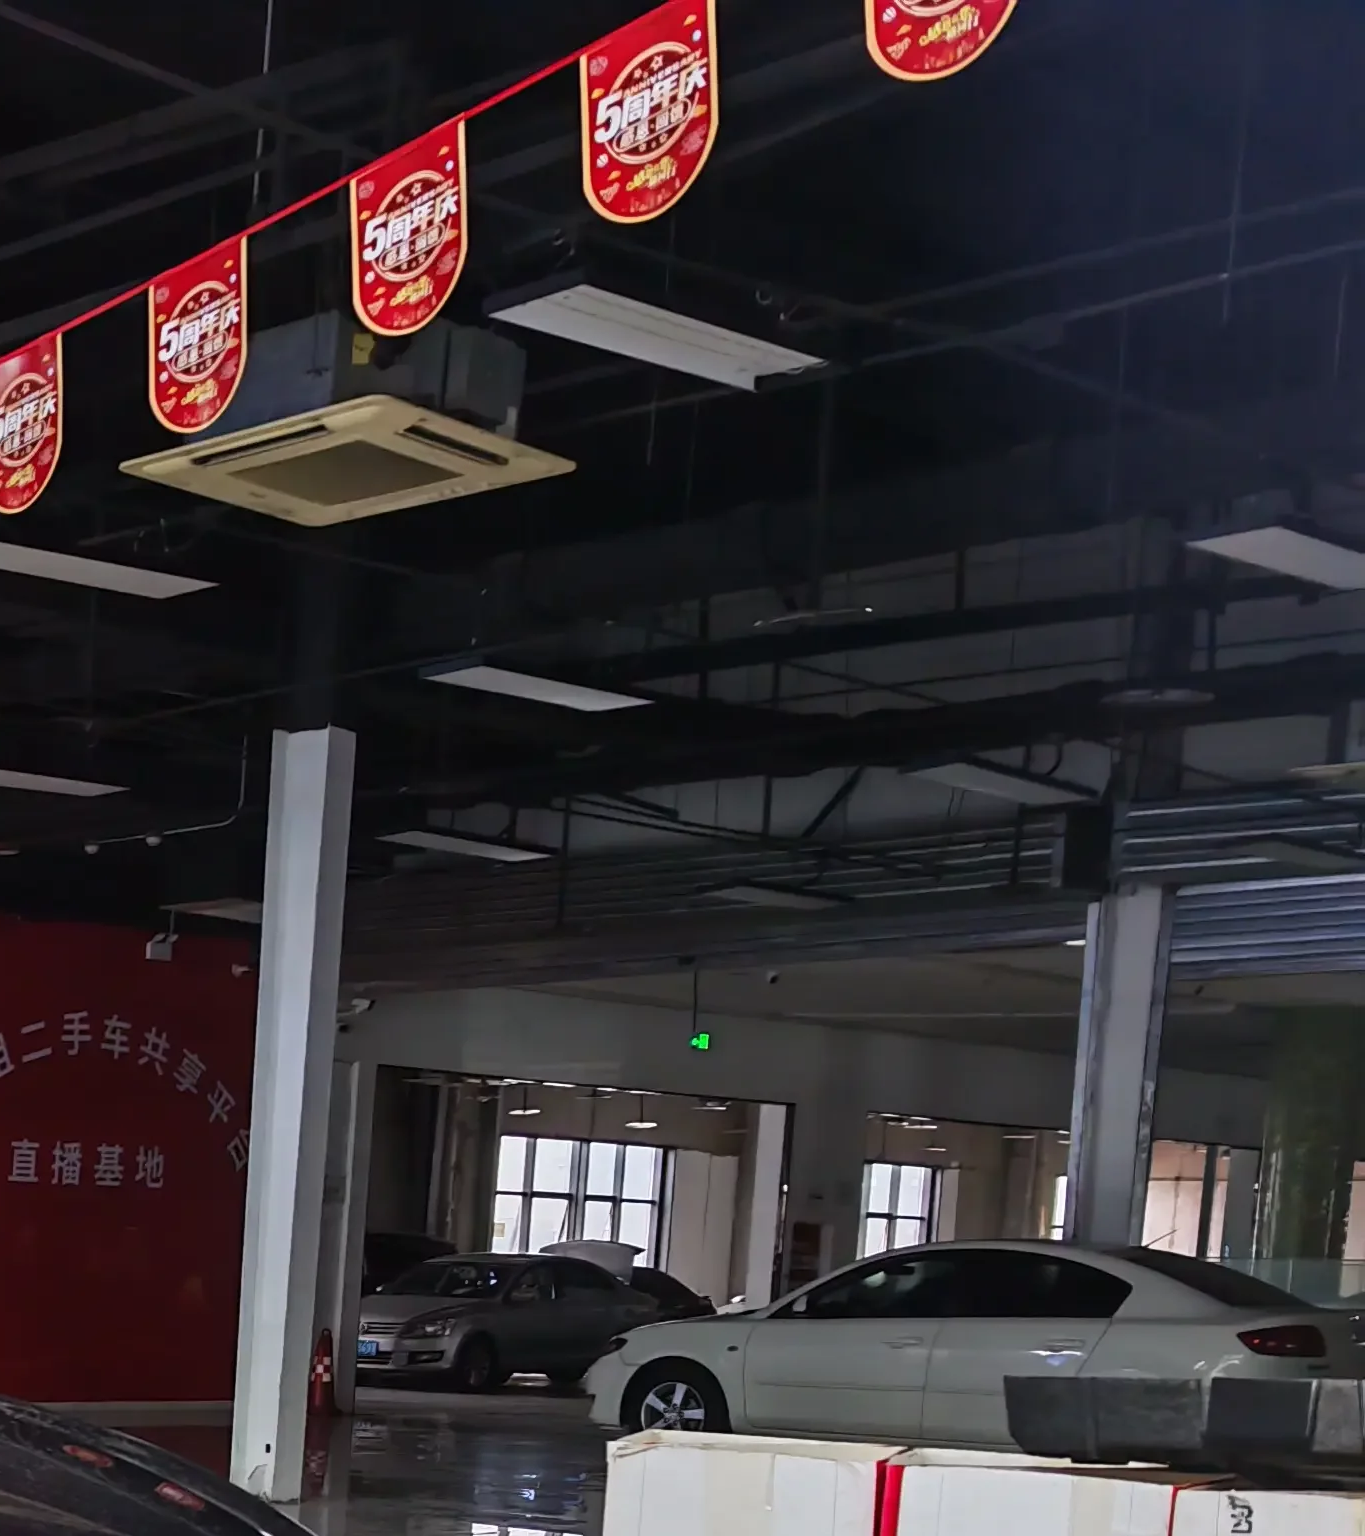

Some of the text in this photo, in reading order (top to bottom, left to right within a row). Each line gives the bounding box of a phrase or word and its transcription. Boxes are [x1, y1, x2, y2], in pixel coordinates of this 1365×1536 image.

[594, 57, 708, 144] 5周年庆
[363, 186, 459, 262] 5周年庆
[158, 298, 241, 362] 5周年庆
[7, 1139, 164, 1188] 直播基地
